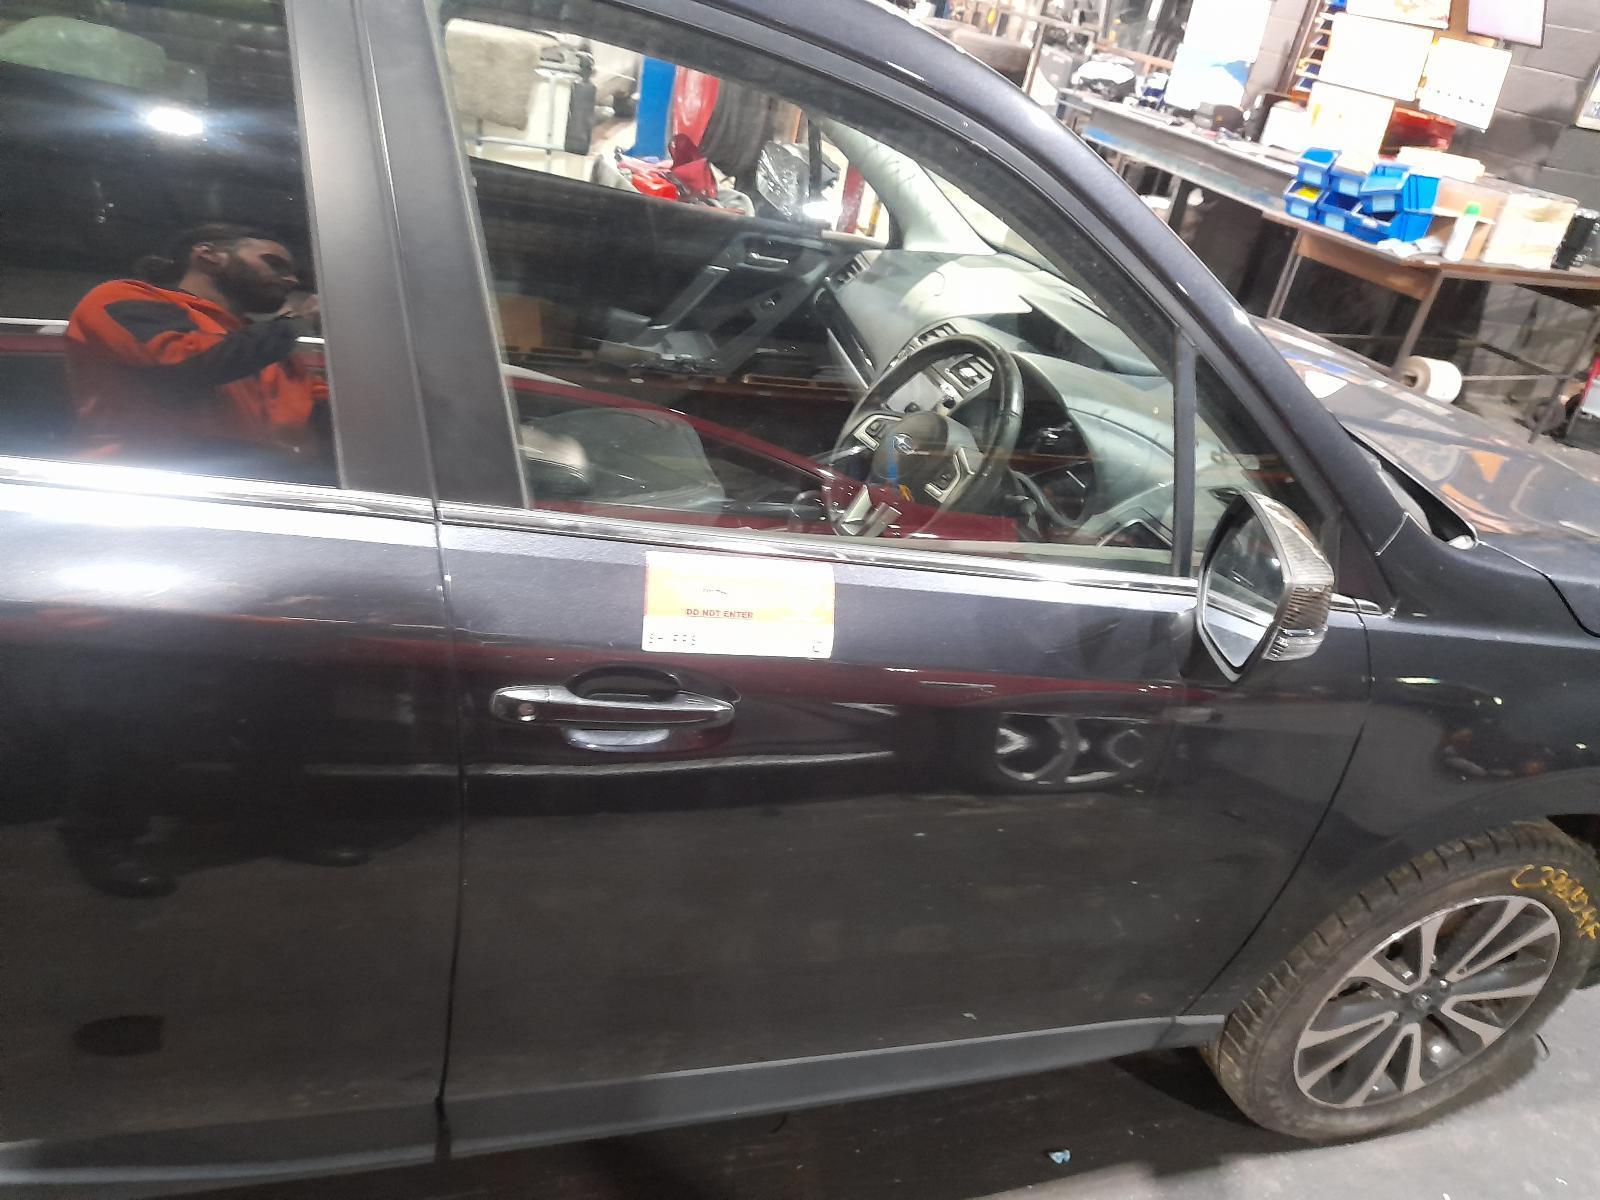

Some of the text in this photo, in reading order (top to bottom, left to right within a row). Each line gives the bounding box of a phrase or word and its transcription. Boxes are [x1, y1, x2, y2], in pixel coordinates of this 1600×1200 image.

[686, 608, 754, 619] DO NOT ENTER
